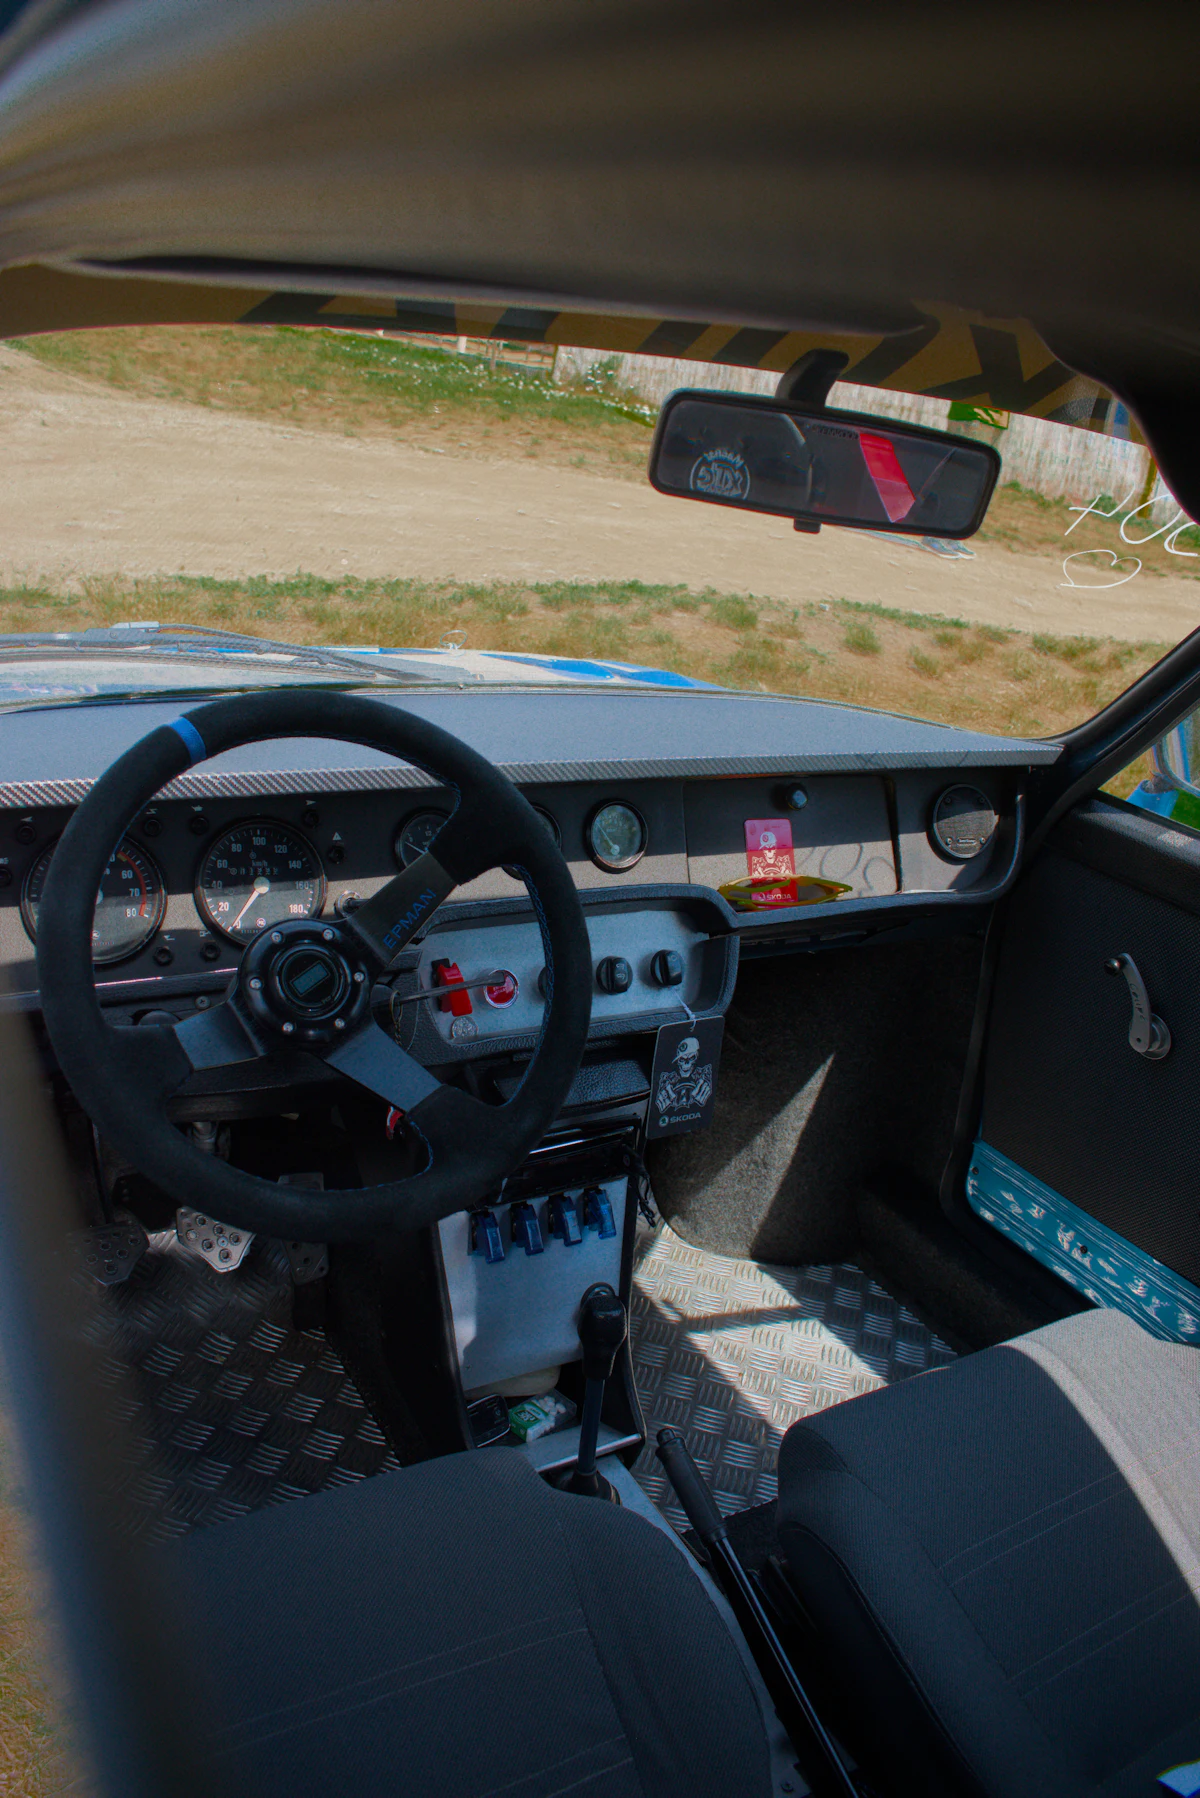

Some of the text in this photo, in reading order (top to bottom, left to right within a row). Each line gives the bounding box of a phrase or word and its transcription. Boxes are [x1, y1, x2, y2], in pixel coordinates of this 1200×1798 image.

[252, 837, 267, 846] 100
[231, 843, 243, 853] 80
[274, 845, 288, 854] 120
[216, 859, 228, 869] 60
[288, 860, 302, 869] 140
[121, 869, 133, 880] 60
[211, 880, 223, 890] 40
[295, 880, 309, 890] 160
[129, 887, 140, 897] 70
[218, 902, 230, 911] 20
[289, 904, 304, 914] 180
[125, 908, 137, 918] 80
[383, 888, 437, 949] EPMAN
